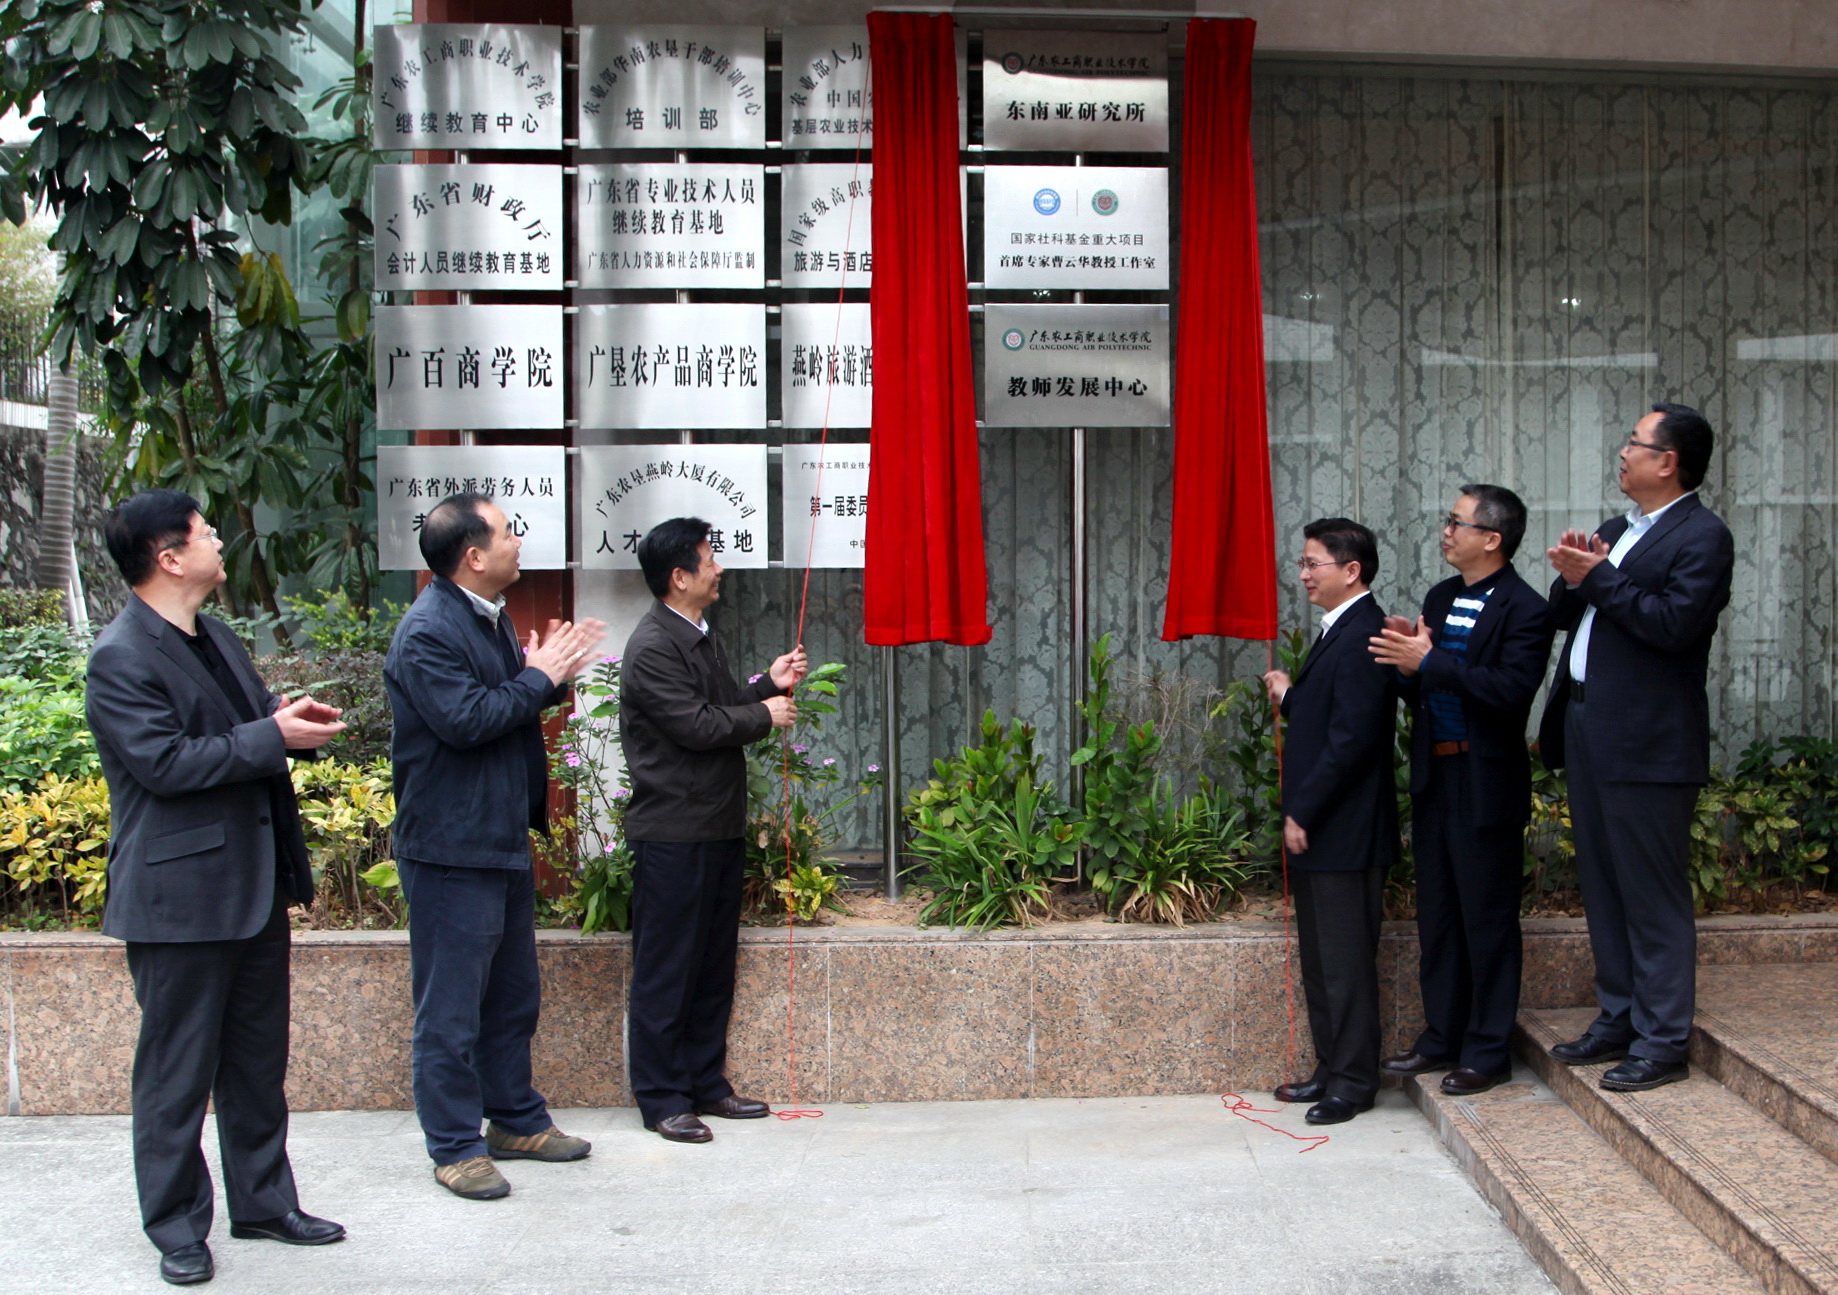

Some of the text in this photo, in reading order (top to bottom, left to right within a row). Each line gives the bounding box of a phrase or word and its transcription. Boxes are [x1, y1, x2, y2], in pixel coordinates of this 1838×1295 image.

[381, 38, 556, 111] 广东农工商职业技术学院
[582, 39, 763, 117] 农业部华南农垦干部培训中心
[827, 89, 873, 109] 中国
[1006, 100, 1146, 122] 东南亚研究所
[395, 112, 540, 134] 继续教育中心
[625, 107, 719, 131] 培训部
[588, 177, 756, 204] 广东省专业技术人员
[385, 182, 551, 242] 广东省财政厅
[612, 209, 724, 235] 继续教育基地
[787, 177, 873, 247] 国家级高职
[1010, 232, 1144, 246] 国家社科基金重大项目
[387, 251, 551, 275] 会计人员继续教育基地
[587, 250, 756, 271] 广东省人力资源和社会保障厅监制
[794, 250, 873, 272] 旅游与酒店
[1000, 254, 1156, 269] 首席专家曹云华教授工作室
[1029, 329, 1152, 343] 广东农工商职业技术学院
[387, 345, 553, 390] 广百商学院
[588, 343, 758, 389] 广垦农产品商学院
[792, 344, 873, 387] 燕岭旅游酒
[1007, 376, 1148, 397] 教师发展中心
[389, 475, 554, 498] 广东省外派劳务人员
[596, 460, 757, 519] 广东农垦燕岭大厦有限公司
[810, 495, 868, 518] 第一届委员
